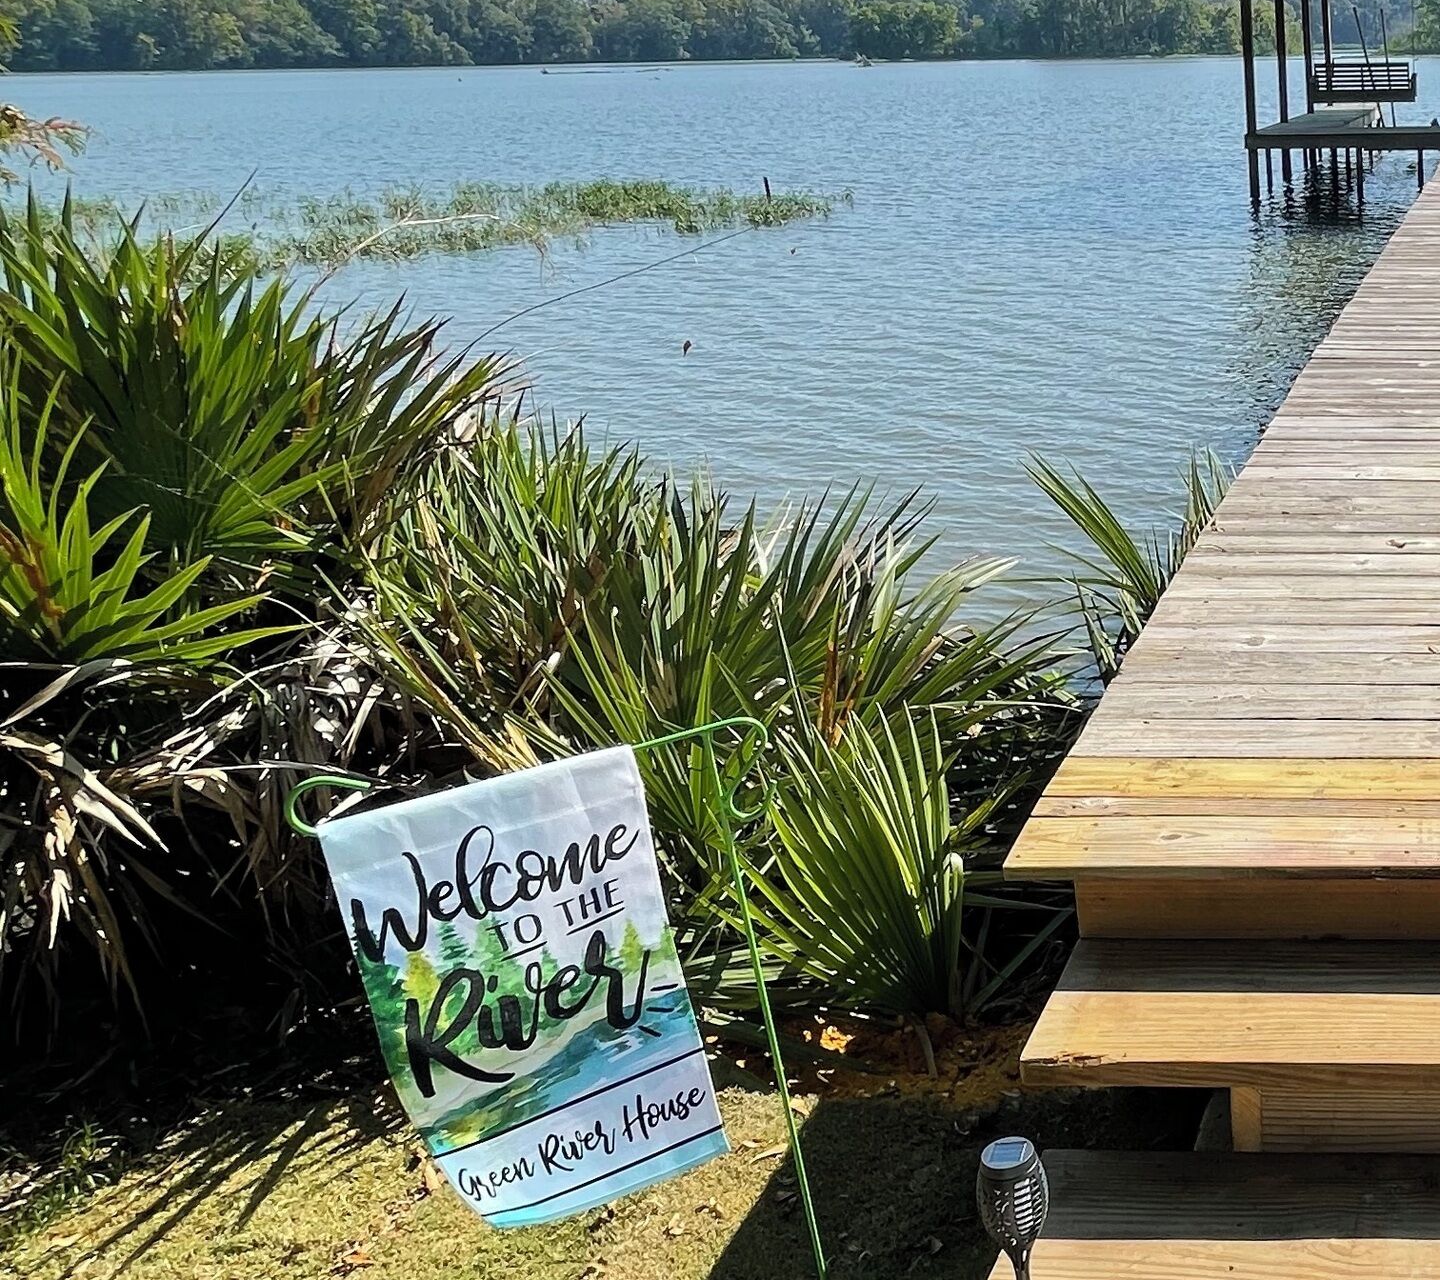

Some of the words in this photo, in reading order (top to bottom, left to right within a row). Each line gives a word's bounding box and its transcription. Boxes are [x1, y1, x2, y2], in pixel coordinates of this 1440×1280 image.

[350, 823, 640, 963] Welcome
[486, 913, 544, 951] TO
[554, 878, 625, 926] THE
[405, 930, 651, 1098] River
[457, 1156, 536, 1202] Green
[538, 1123, 617, 1175] River
[622, 1085, 707, 1143] House
